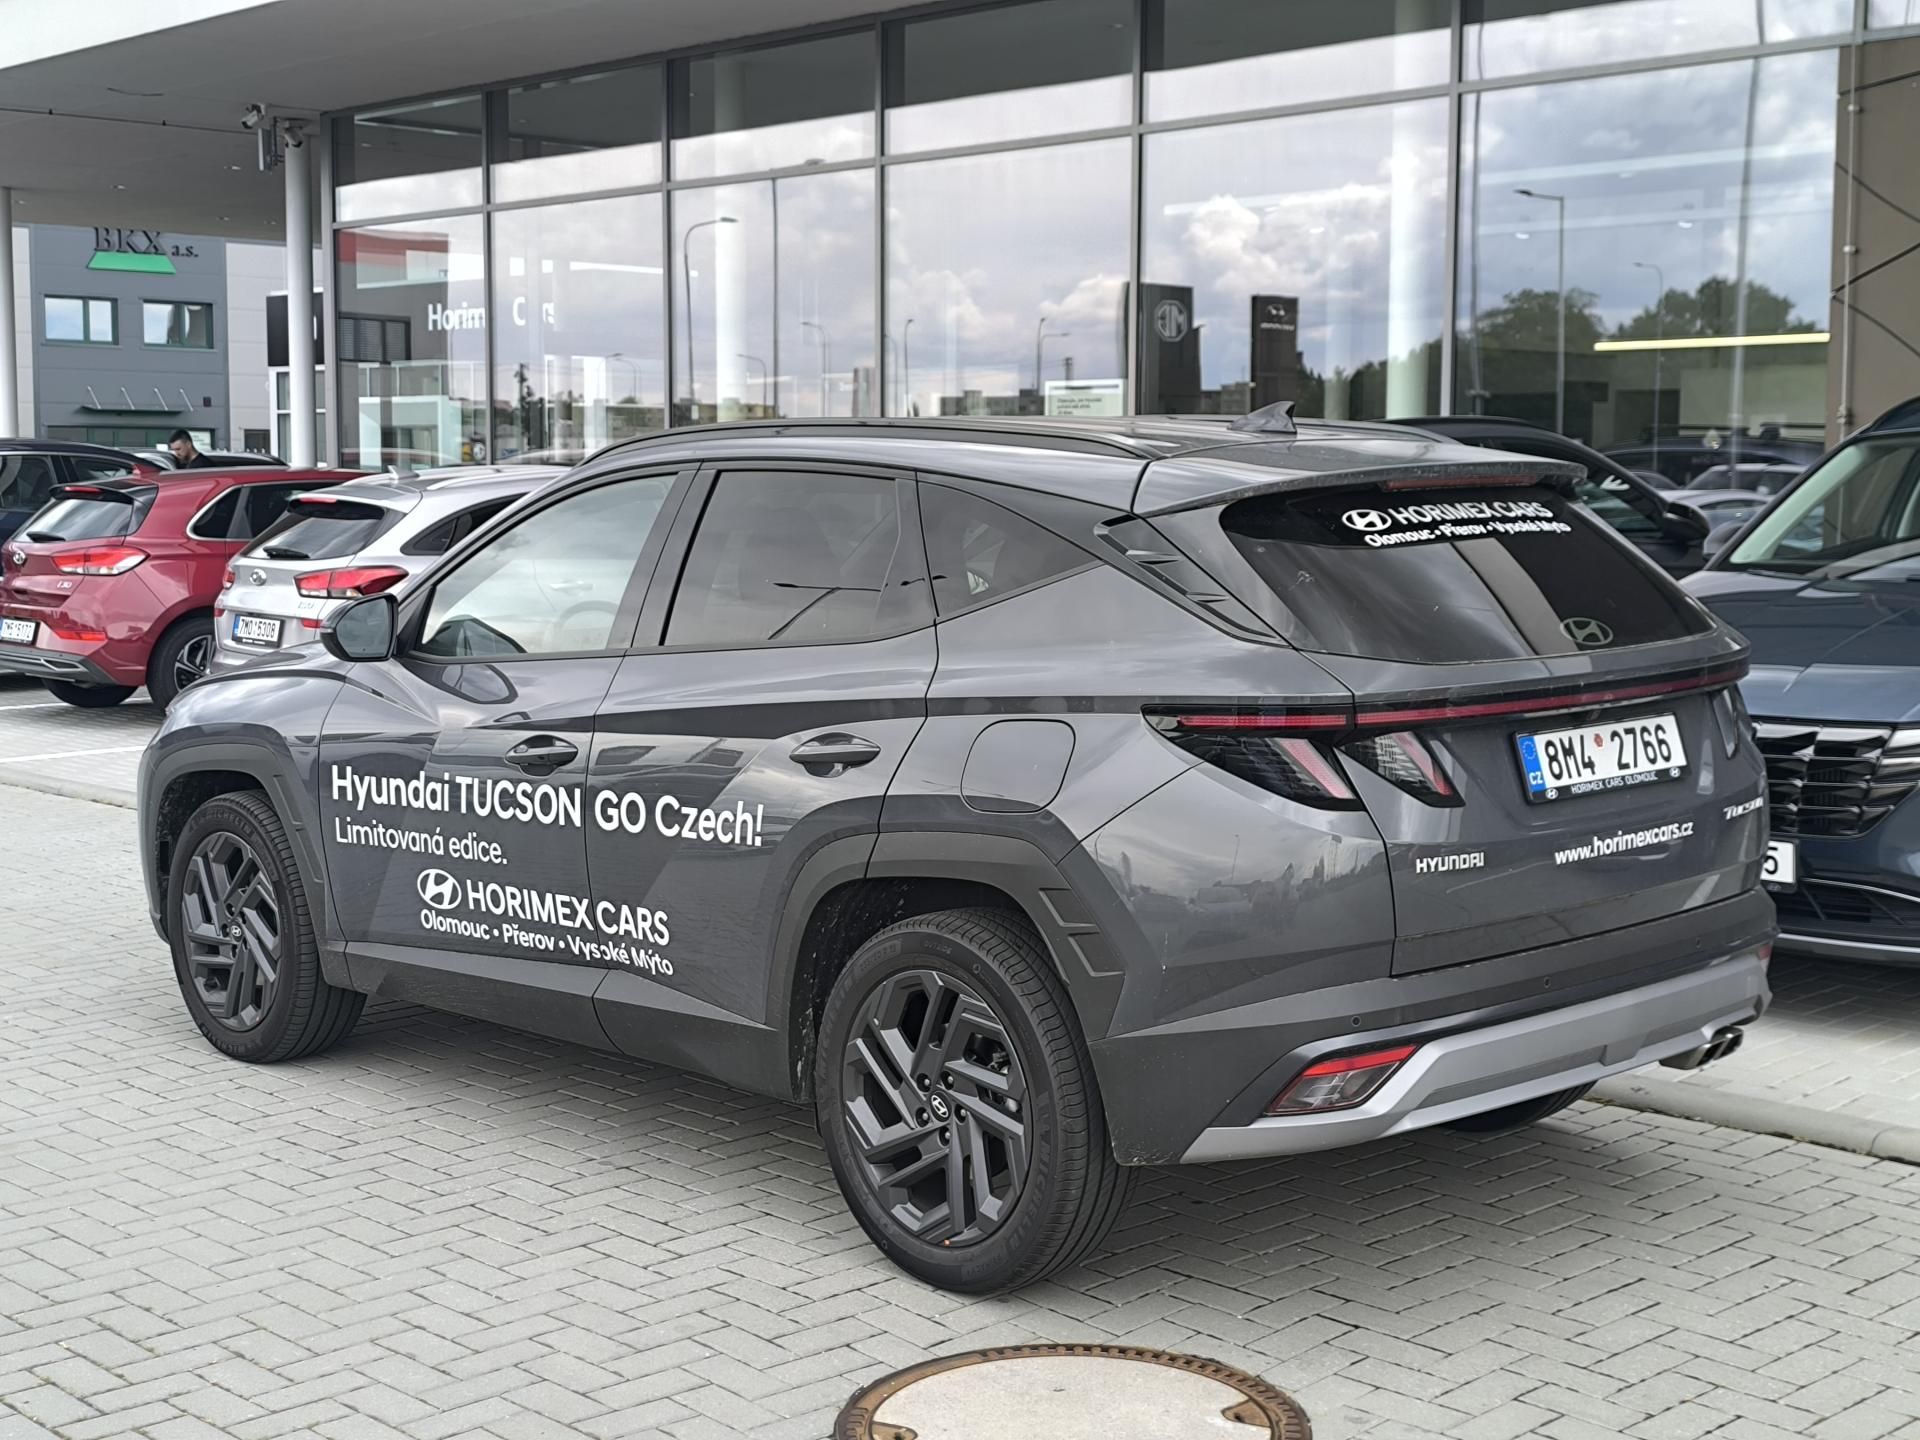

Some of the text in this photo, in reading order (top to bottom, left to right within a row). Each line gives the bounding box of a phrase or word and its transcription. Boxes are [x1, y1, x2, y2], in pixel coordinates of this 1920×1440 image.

[94, 226, 167, 256] BKX
[1389, 502, 1554, 525] HORIMEX CARS
[1364, 527, 1436, 548] Olomouc
[1438, 522, 1488, 538] Přerov
[1544, 723, 1672, 781] 8M4 2766
[1529, 771, 1544, 785] CZ
[1571, 771, 1659, 795] HORIMEX CARS OLOMOUC
[331, 763, 765, 847] Hyundai TUCSON GO Czech!
[335, 816, 508, 865] Limitovaná edice.
[1554, 820, 1694, 866] www.horimexcars.cz
[1415, 852, 1485, 874] HYUNDAI
[466, 878, 671, 947] HORIMEX CARS
[420, 908, 675, 976] Olomouc Přerov Vysoké Mýto
